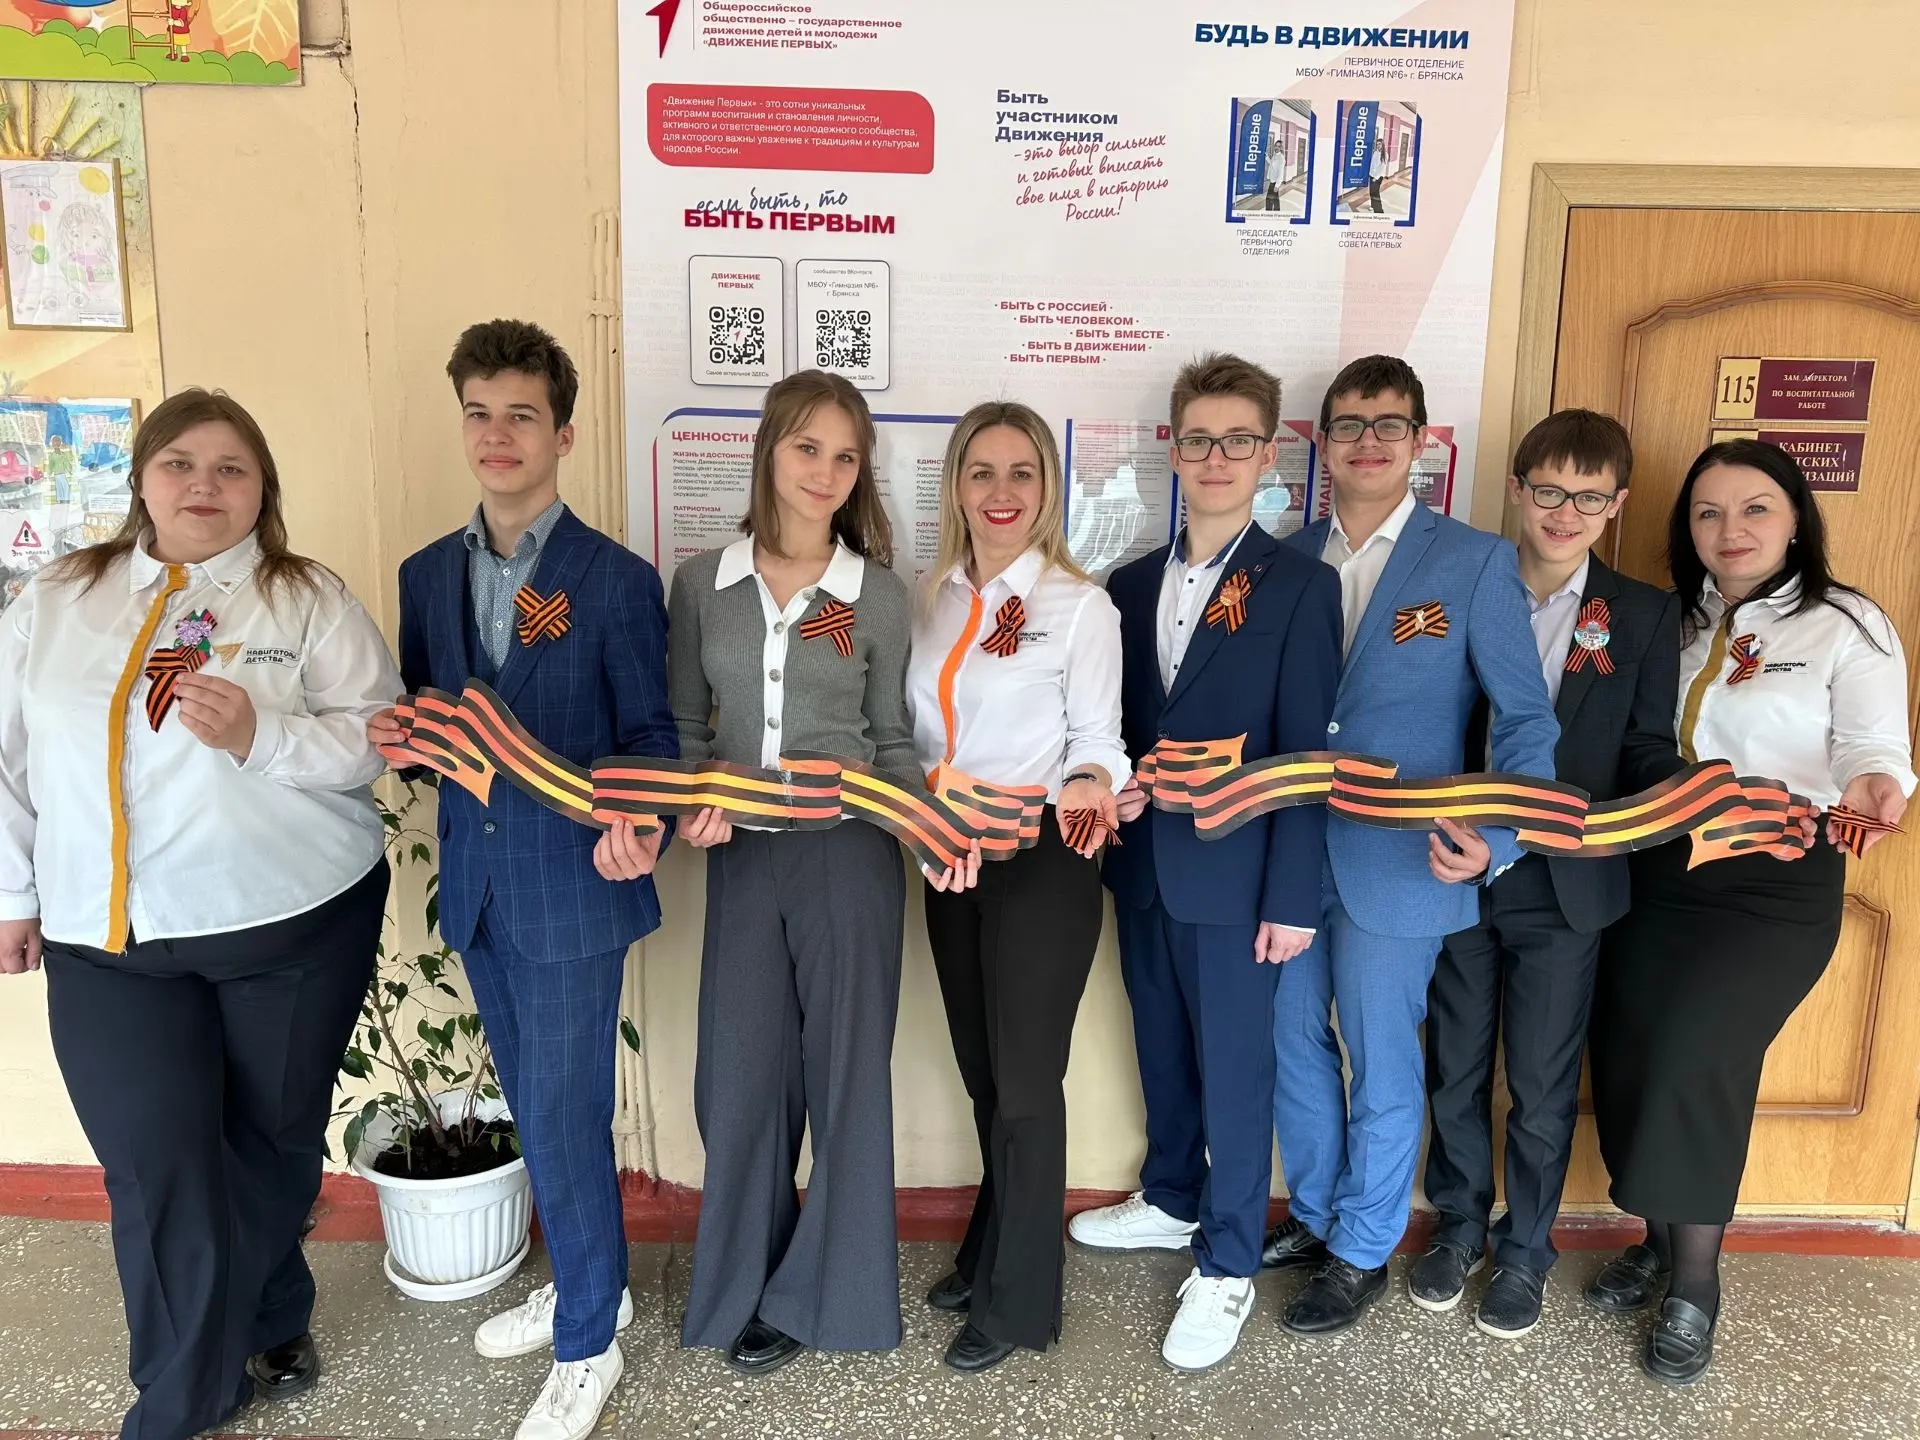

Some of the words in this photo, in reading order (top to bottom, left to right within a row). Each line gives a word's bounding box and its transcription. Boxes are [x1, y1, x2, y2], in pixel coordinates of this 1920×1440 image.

[703, 1, 812, 13] Общероссийское
[703, 14, 786, 25] общественно
[798, 18, 902, 28] государственное
[703, 27, 764, 36] движение
[767, 28, 802, 37] детей
[814, 30, 878, 40] молодежи
[1195, 23, 1269, 48] БУДЬ
[1275, 26, 1293, 45] В
[1298, 26, 1469, 50] ДВИЖЕНИИ
[703, 38, 779, 48] «ДВИЖЕНИЕ
[781, 40, 838, 49] ПЕРВЫХ»
[1344, 58, 1403, 67] ПЕРВИЧНОЕ
[1406, 58, 1465, 69] ОТДЕЛЕНИЕ
[1296, 68, 1325, 77] МБОУ
[1326, 68, 1385, 79] «ГИМНАЗИЯ
[1418, 71, 1463, 81] БРЯНСКА
[996, 89, 1049, 104] Быть
[766, 100, 780, 108] это
[812, 102, 866, 111] уникальных
[663, 110, 709, 118] программ
[712, 110, 765, 119] воспитания
[776, 112, 834, 121] становления
[837, 115, 882, 124] личности,
[996, 110, 1118, 125] участником
[663, 121, 709, 130] активного
[720, 123, 791, 132] ответственного
[794, 126, 857, 134] молодежного
[859, 127, 918, 137] сообщества,
[995, 126, 1104, 143] Движения
[682, 134, 723, 142] которого
[758, 136, 802, 145] уважение
[811, 138, 862, 147] традициям
[872, 140, 919, 149] культурам
[1244, 113, 1262, 172] Первые
[1351, 106, 1369, 167] Первые
[664, 145, 702, 154] народов
[705, 145, 741, 154] России.
[1059, 138, 1100, 163] выбор
[1105, 135, 1166, 152] сильных
[1018, 172, 1029, 184] и
[1032, 159, 1093, 182] готовых
[1099, 156, 1163, 175] вписать
[1016, 186, 1045, 206] свое
[1050, 190, 1082, 203] имя
[1087, 179, 1096, 197] в
[1100, 178, 1169, 202] историю
[696, 199, 743, 213] если
[750, 187, 809, 211] быть,
[819, 190, 848, 208] то
[1066, 197, 1124, 222] России!
[684, 209, 763, 230] БЫТЬ
[770, 212, 895, 234] ПЕРВЫМ
[1341, 232, 1403, 240] ПРЕДСЕДАТЕЛЬ
[1240, 238, 1293, 247] ПЕРВИЧНОГО
[1338, 240, 1369, 248] СОВЕТА
[1242, 248, 1290, 256] ОТДЕЛЕНИЯ
[711, 272, 761, 281] ДВИЖЕНИЕ
[718, 282, 755, 290] ПЕРВЫХ
[832, 290, 860, 298] Брянска
[1000, 302, 1035, 311] БЫТЬ
[1037, 302, 1046, 311] С
[1048, 301, 1107, 312] РОССИЕЙ
[1020, 316, 1054, 324] БЫТЬ
[1056, 316, 1133, 325] ЧЕЛОВЕКОМ
[1076, 330, 1110, 338] БЫТЬ
[1115, 330, 1164, 339] ВМЕСТЕ
[1028, 342, 1062, 350] БЫТЬ
[1064, 342, 1072, 351] В
[1074, 342, 1146, 352] ДВИЖЕНИИ
[1010, 354, 1044, 362] БЫТЬ
[1046, 354, 1100, 364] ПЕРВЫМ
[1802, 374, 1847, 382] ДИРЕКТОРА
[1721, 375, 1756, 404] 115
[1786, 390, 1855, 398] ВОСПИТАТЕЛЬНОЙ
[672, 430, 749, 443] ЦЕННОСТИ
[1779, 442, 1842, 453] КАБИНЕТ
[1793, 456, 1839, 468] ТСКИХ
[1802, 470, 1856, 483] ИЗАЦИЙ
